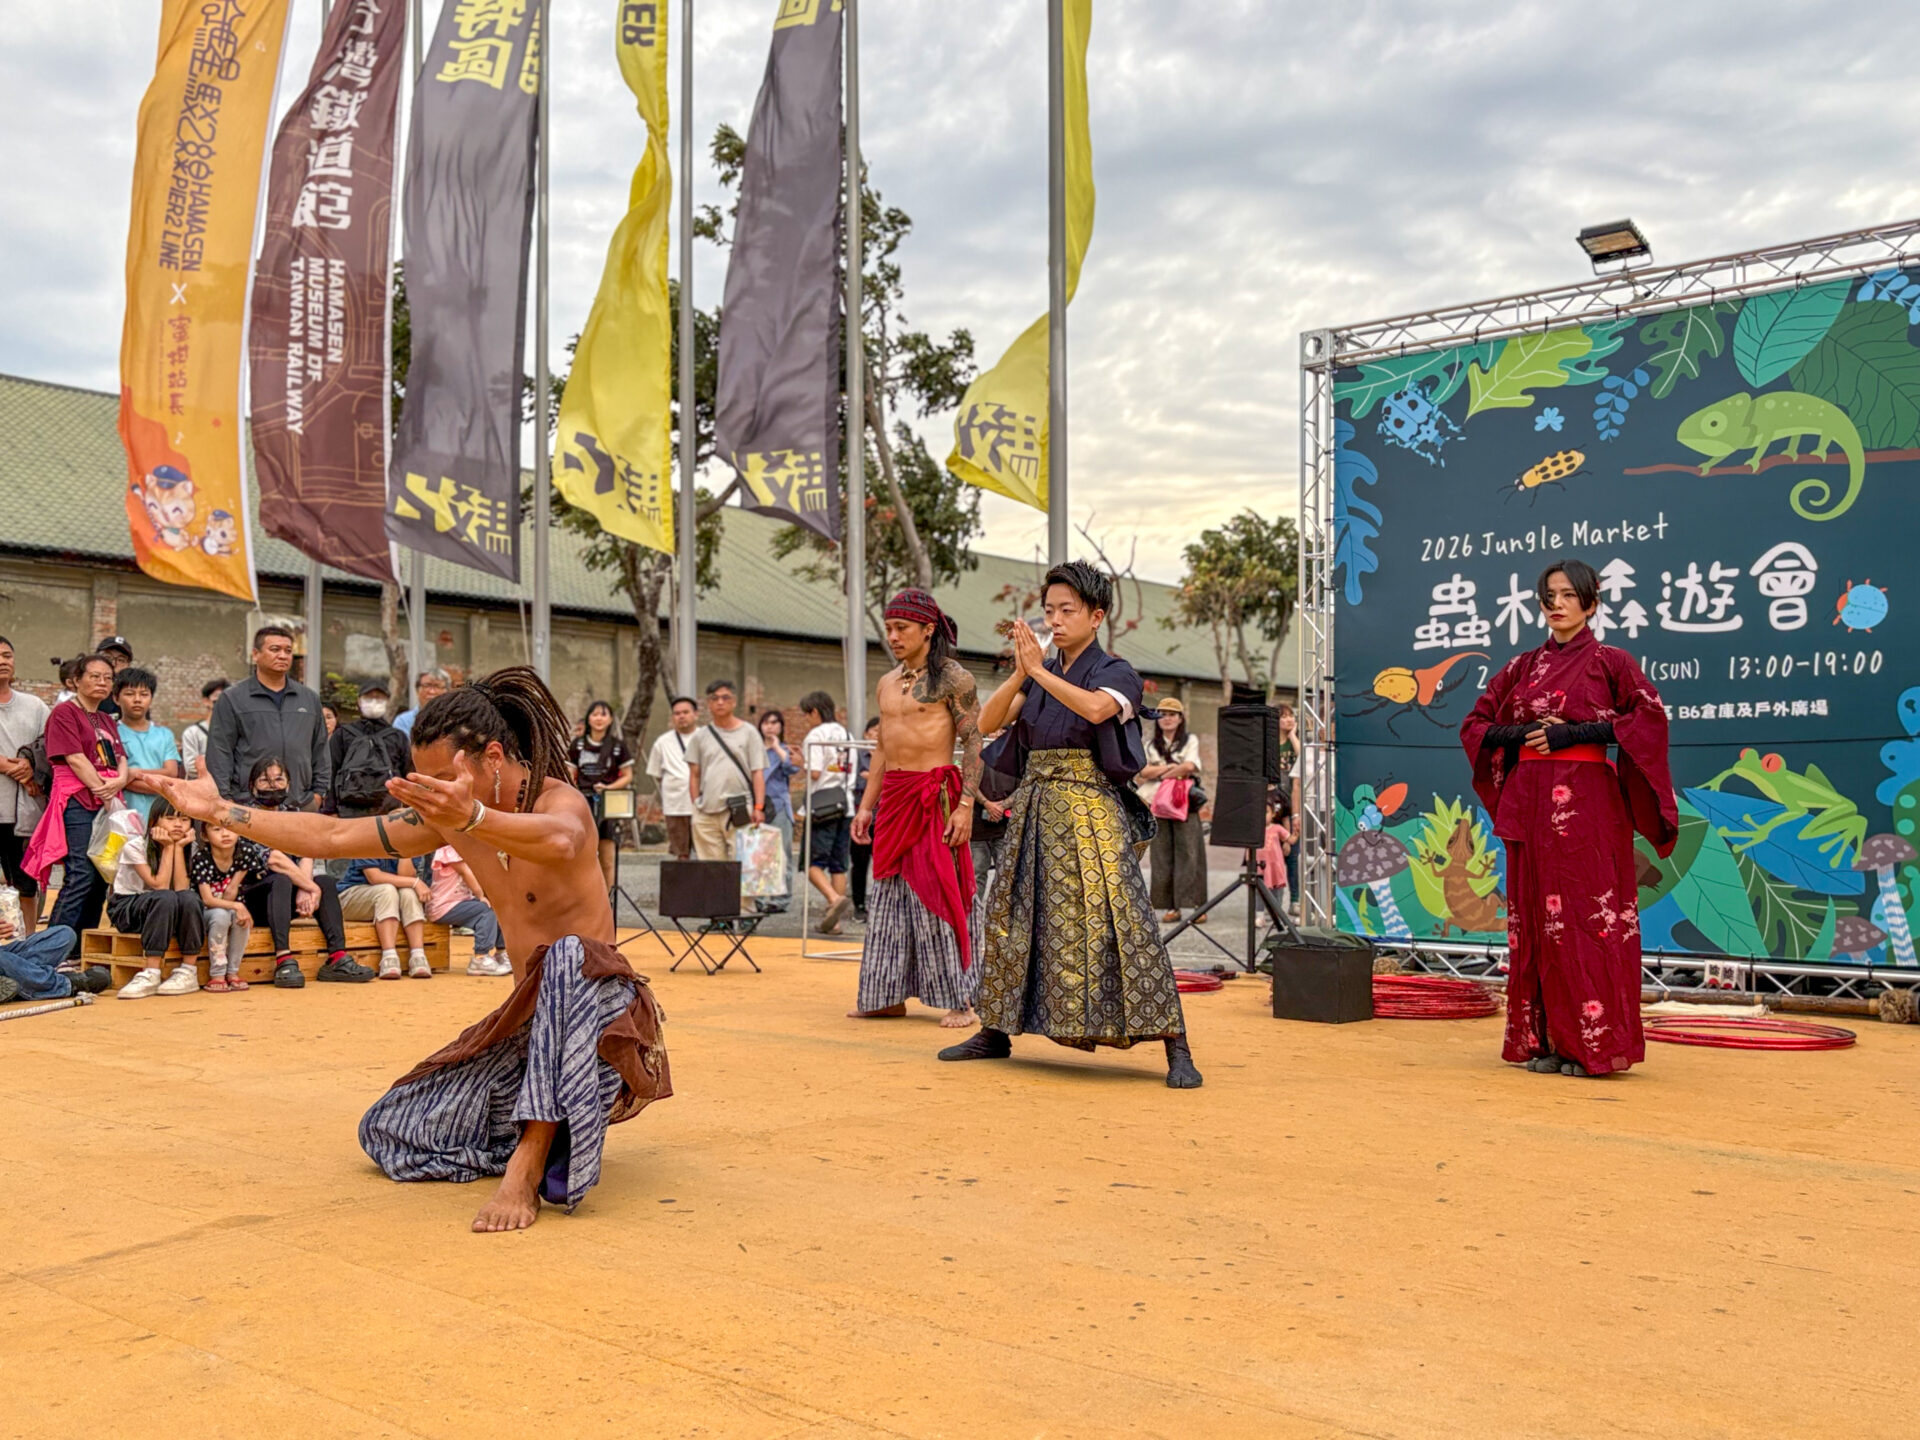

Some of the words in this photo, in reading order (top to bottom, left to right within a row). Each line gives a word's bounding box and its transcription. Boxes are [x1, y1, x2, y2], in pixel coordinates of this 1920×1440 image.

[164, 174, 189, 228] PIER2
[181, 181, 212, 273] HAMASEN
[159, 230, 181, 272] LINE
[288, 256, 304, 336] TAIWAN
[307, 256, 325, 347] MUSEUM
[327, 258, 346, 363] HAMASEN
[286, 342, 304, 435] RAILWAY
[306, 353, 323, 382] OF
[1420, 533, 1473, 562] 2026
[1480, 524, 1564, 556] Jungle
[1572, 511, 1669, 547] Market
[1729, 650, 1884, 680] 13:00-19:00
